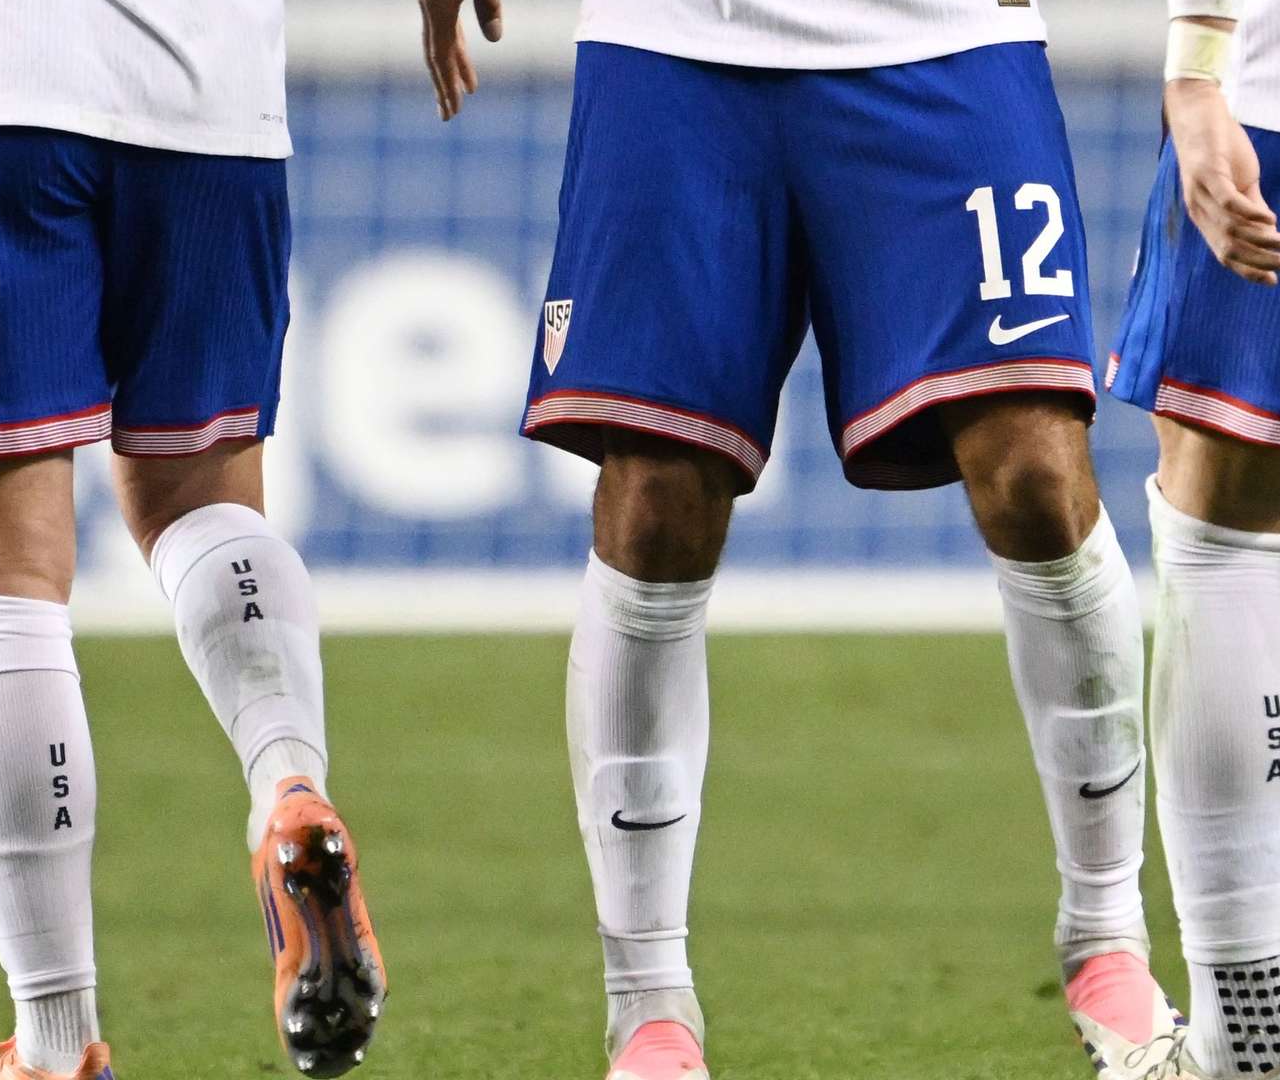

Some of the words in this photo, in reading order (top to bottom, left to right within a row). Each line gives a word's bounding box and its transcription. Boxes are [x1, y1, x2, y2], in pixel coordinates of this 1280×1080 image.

[965, 182, 1075, 301] 12
[546, 304, 571, 332] USA
[231, 559, 264, 623] USA
[49, 742, 72, 831] USA
